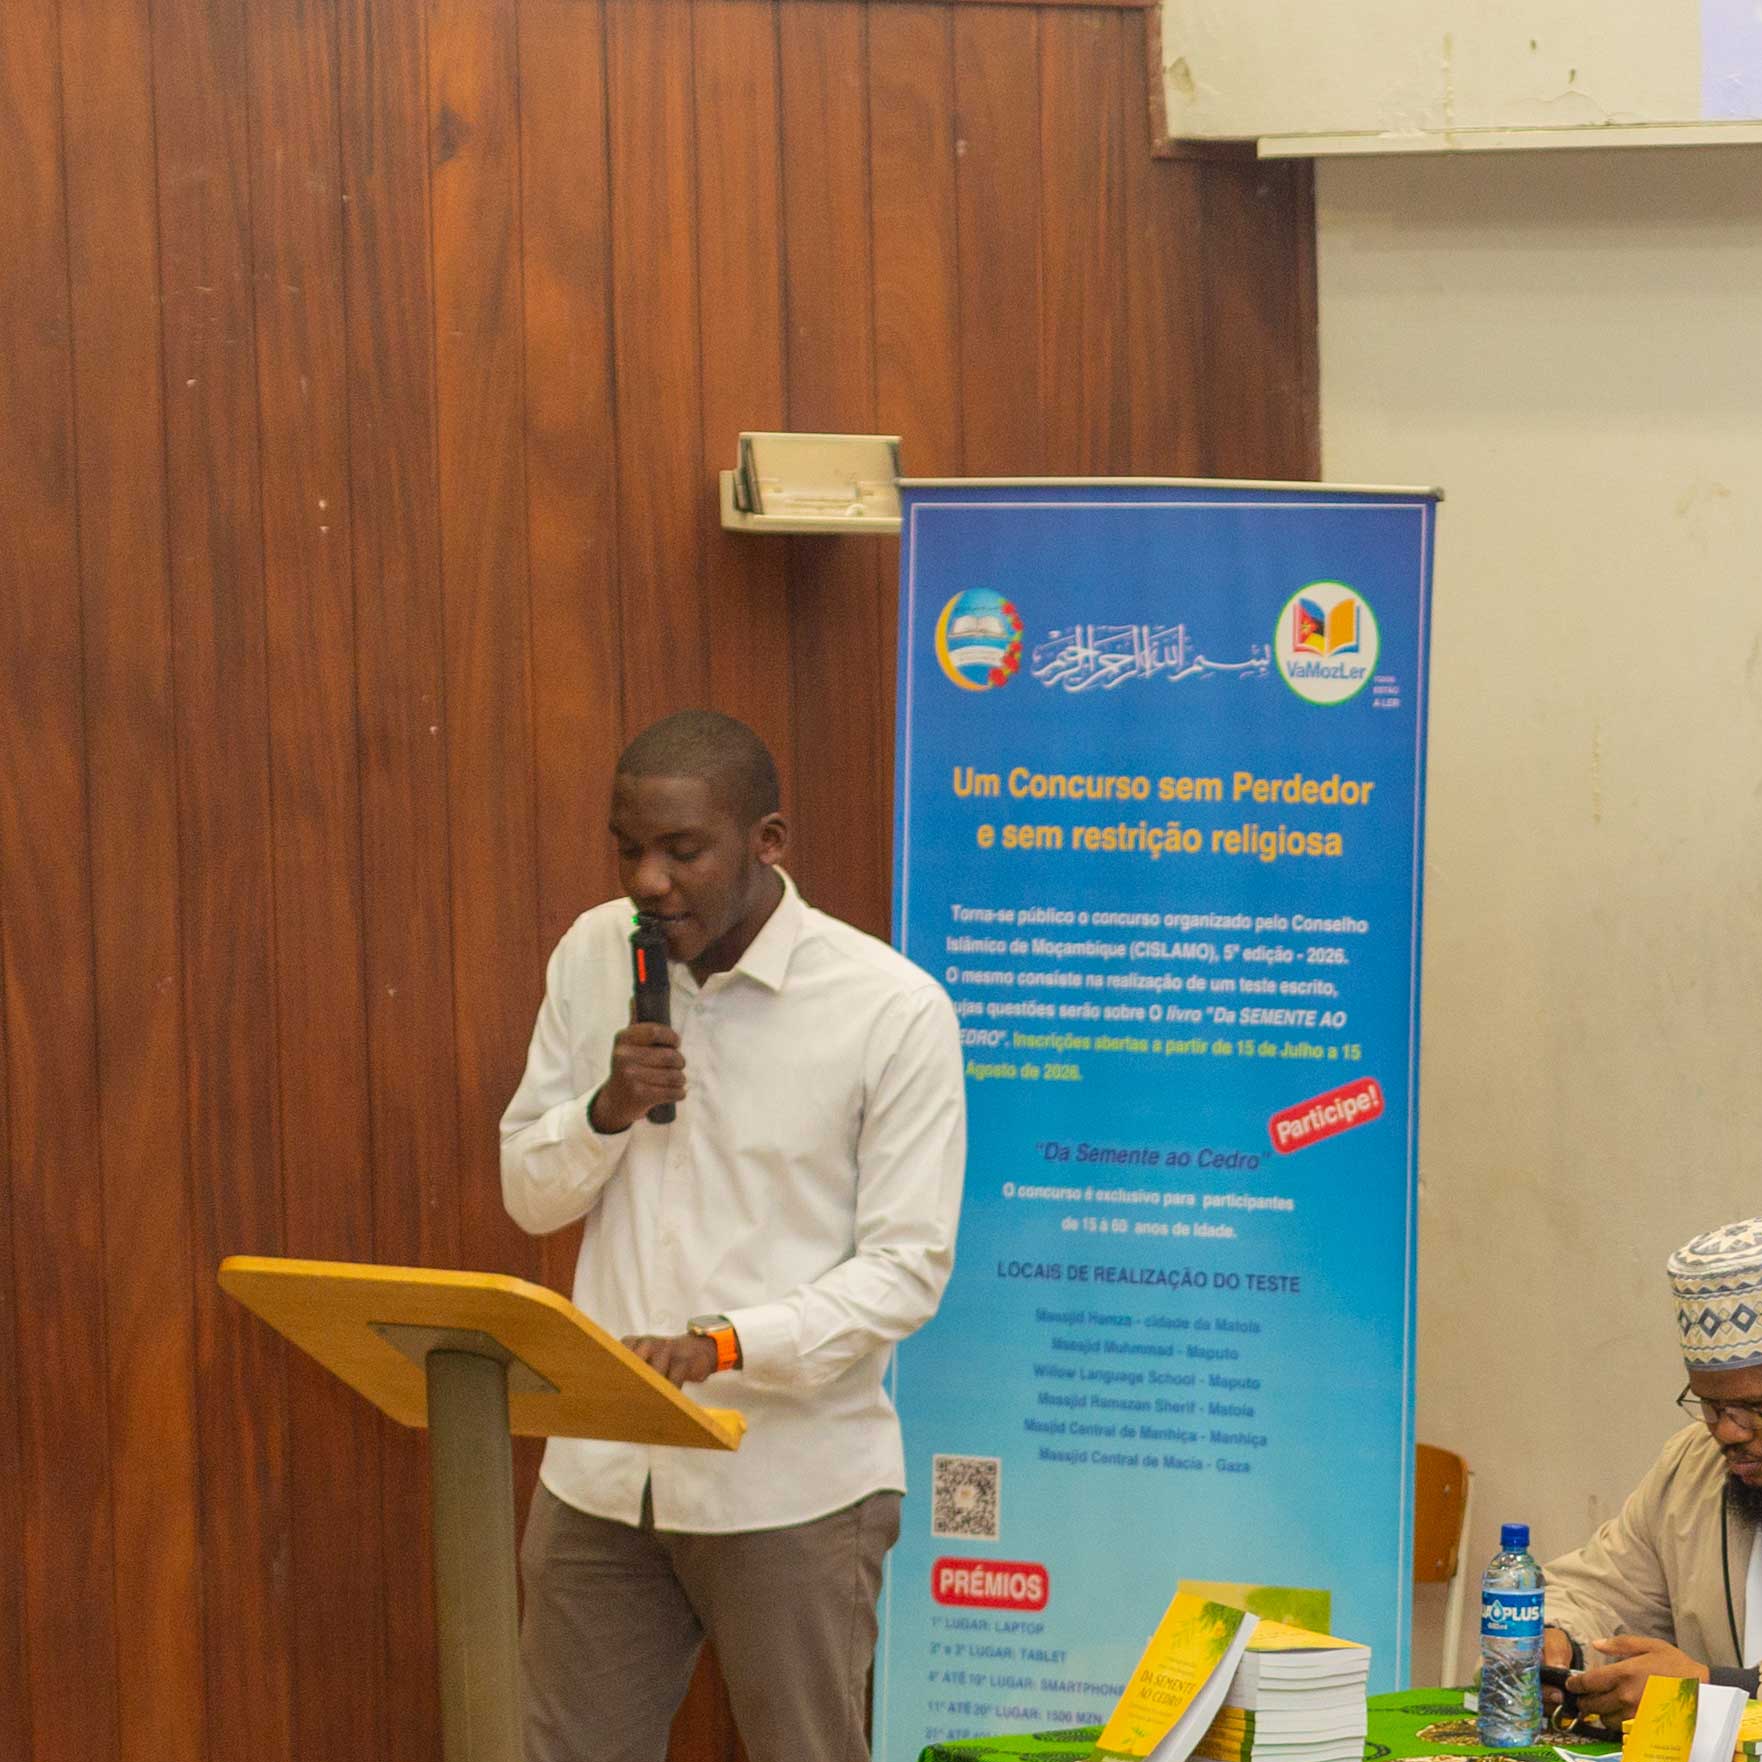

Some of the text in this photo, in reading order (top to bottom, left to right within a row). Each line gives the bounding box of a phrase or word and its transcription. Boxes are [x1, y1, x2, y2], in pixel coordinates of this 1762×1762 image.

[1286, 660, 1366, 681] VaMozLer
[953, 766, 1375, 805] Um Concurso sem Perdedor
[977, 820, 1342, 862] e sem restrição religiosa
[951, 904, 1369, 934] Torna-se público o concurso organizado pelo Conselho
[946, 936, 1006, 954] Islâmico
[1009, 938, 1029, 954] de
[1031, 937, 1126, 960] Moçambique
[1242, 945, 1294, 965] edição
[945, 966, 958, 983] O
[961, 969, 1013, 985] mesmo
[1017, 970, 1083, 988] consiste
[1086, 974, 1103, 988] na
[1106, 973, 1182, 994] realização
[1186, 975, 1207, 991] de
[1210, 978, 1235, 992] um
[1239, 977, 1276, 994] teste
[953, 1000, 983, 1018] ujas
[986, 1000, 1055, 1021] questões
[1059, 1002, 1100, 1020] serão
[1103, 1004, 1145, 1021] sobre
[1149, 1004, 1163, 1021] O
[1166, 1005, 1202, 1022] livro
[1239, 1007, 1317, 1027] SEMENTE
[1319, 1010, 1347, 1029] AO
[1012, 1031, 1090, 1052] Inscrições
[1152, 1040, 1161, 1053] a
[1166, 1038, 1208, 1057] partir
[1212, 1039, 1232, 1055] de
[1237, 1039, 1255, 1056] 15
[1258, 1041, 1277, 1057] de
[1280, 1041, 1324, 1059] Julho
[1328, 1046, 1338, 1059] a
[1343, 1044, 1362, 1061] 15
[1020, 1063, 1040, 1079] de
[1276, 1084, 1381, 1146] Participe!
[1075, 1143, 1160, 1167] Semente
[1165, 1151, 1190, 1167] ao
[1002, 1182, 1294, 1212] O concurso é exclusivo para participantes
[1062, 1217, 1078, 1231] de
[1135, 1222, 1169, 1236] anos
[1172, 1221, 1190, 1237] de
[997, 1260, 1300, 1294] LOCAIS DE REALIZAÇÃO DO TESTE
[1186, 1344, 1239, 1361] Maputo
[1080, 1366, 1143, 1386] Language
[1148, 1370, 1196, 1386] School
[1208, 1374, 1261, 1391] Maputo
[1069, 1421, 1116, 1438] Central
[1120, 1424, 1137, 1438] de
[1091, 1451, 1138, 1467] Central
[1142, 1454, 1159, 1468] de
[1216, 1458, 1250, 1473] Gaza
[940, 1565, 1042, 1600] PRÉMIOS
[994, 1621, 1044, 1636] LAPTOP
[1020, 1648, 1067, 1663] TABLET
